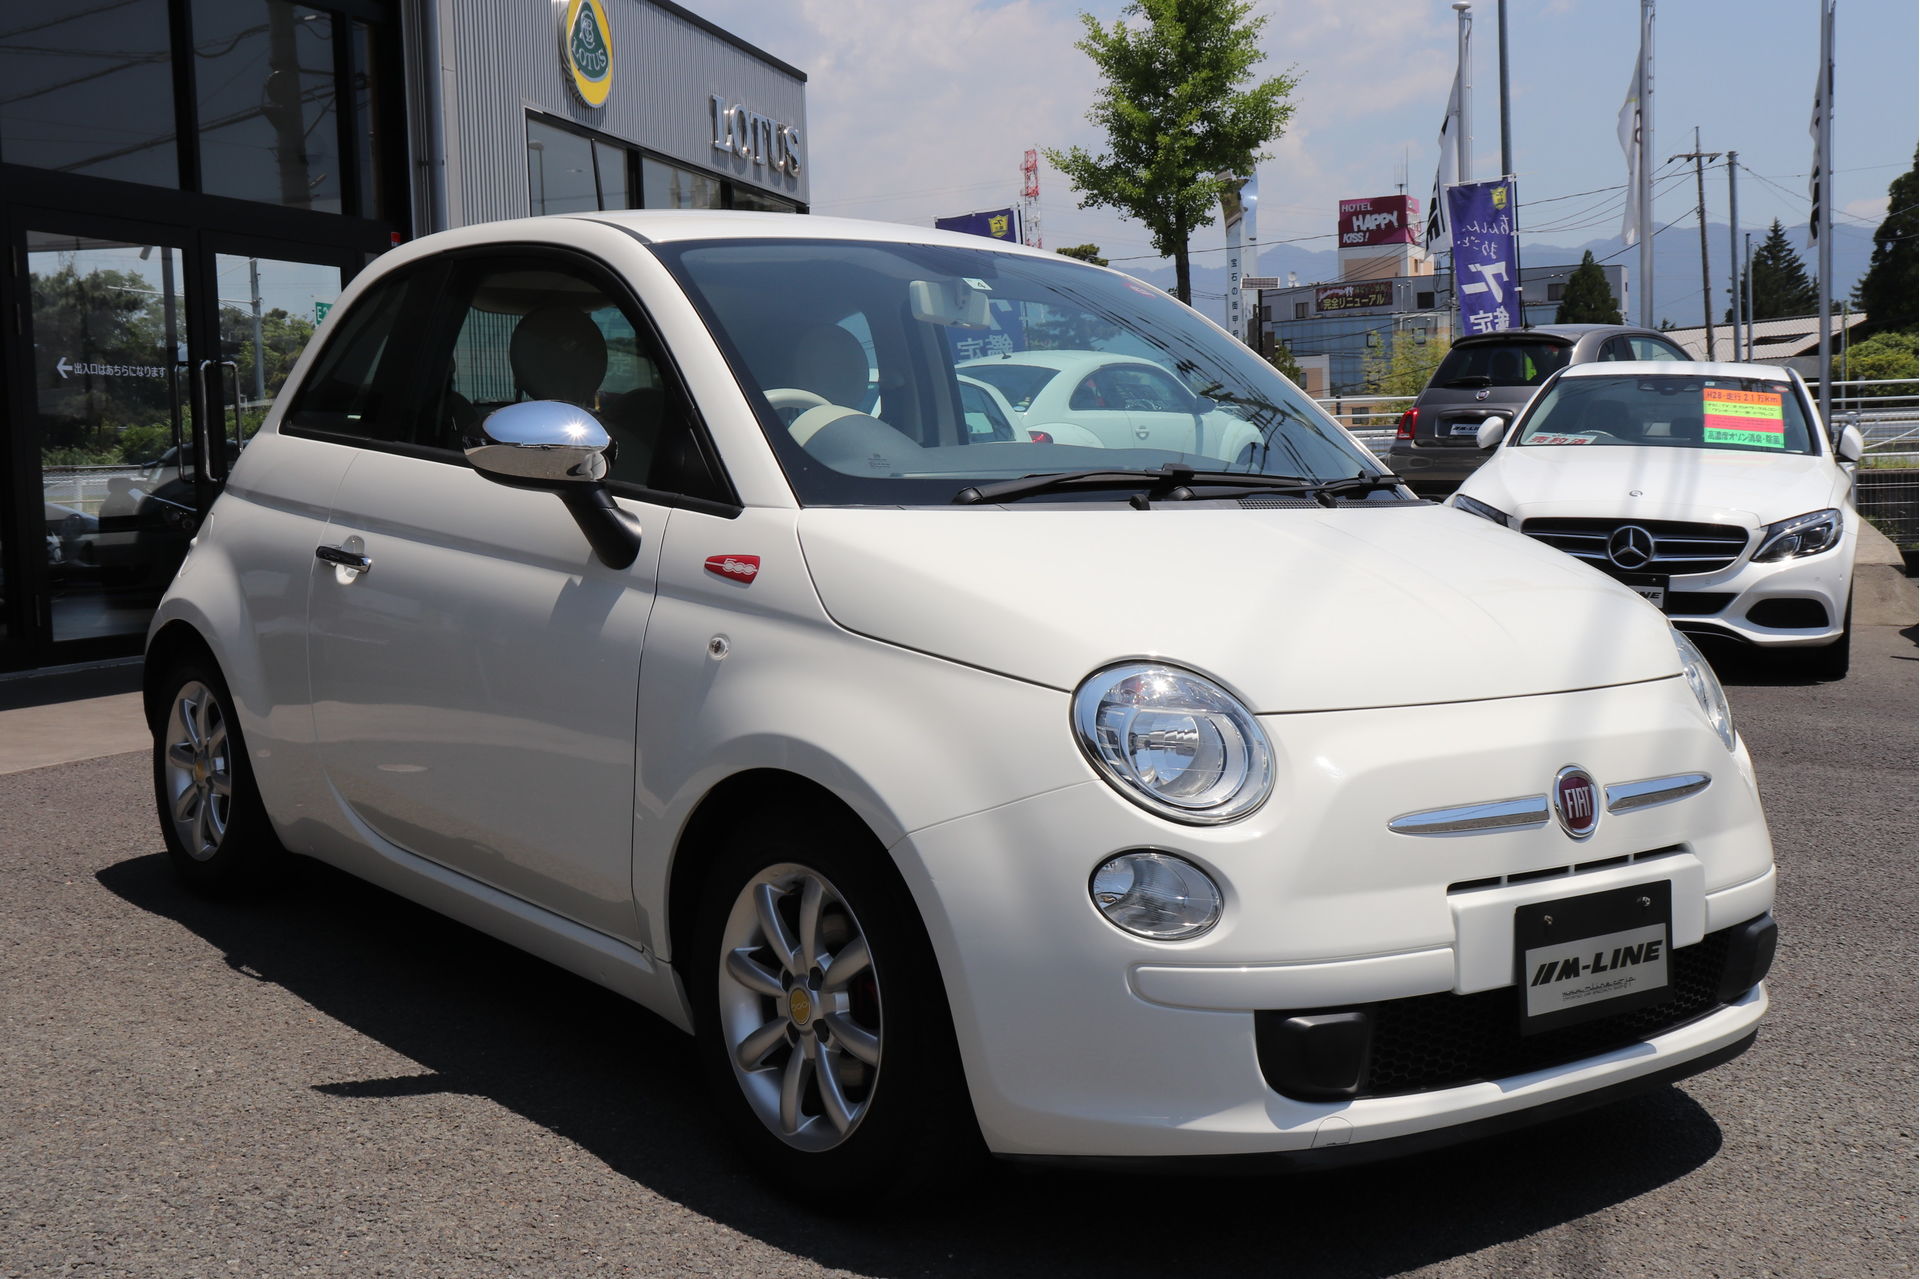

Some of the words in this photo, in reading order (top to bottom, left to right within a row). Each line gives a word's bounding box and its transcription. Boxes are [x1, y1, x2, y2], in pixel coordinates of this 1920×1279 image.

[571, 37, 606, 70] LOTUS
[710, 94, 801, 178] LOTUS
[1341, 202, 1372, 212] HOTEL
[1352, 211, 1399, 231] HAPPY
[1323, 294, 1385, 309] 完全リニューアル
[73, 363, 166, 377] 出入口はあちらになります
[723, 558, 756, 575] 500
[1564, 786, 1592, 819] FIAT
